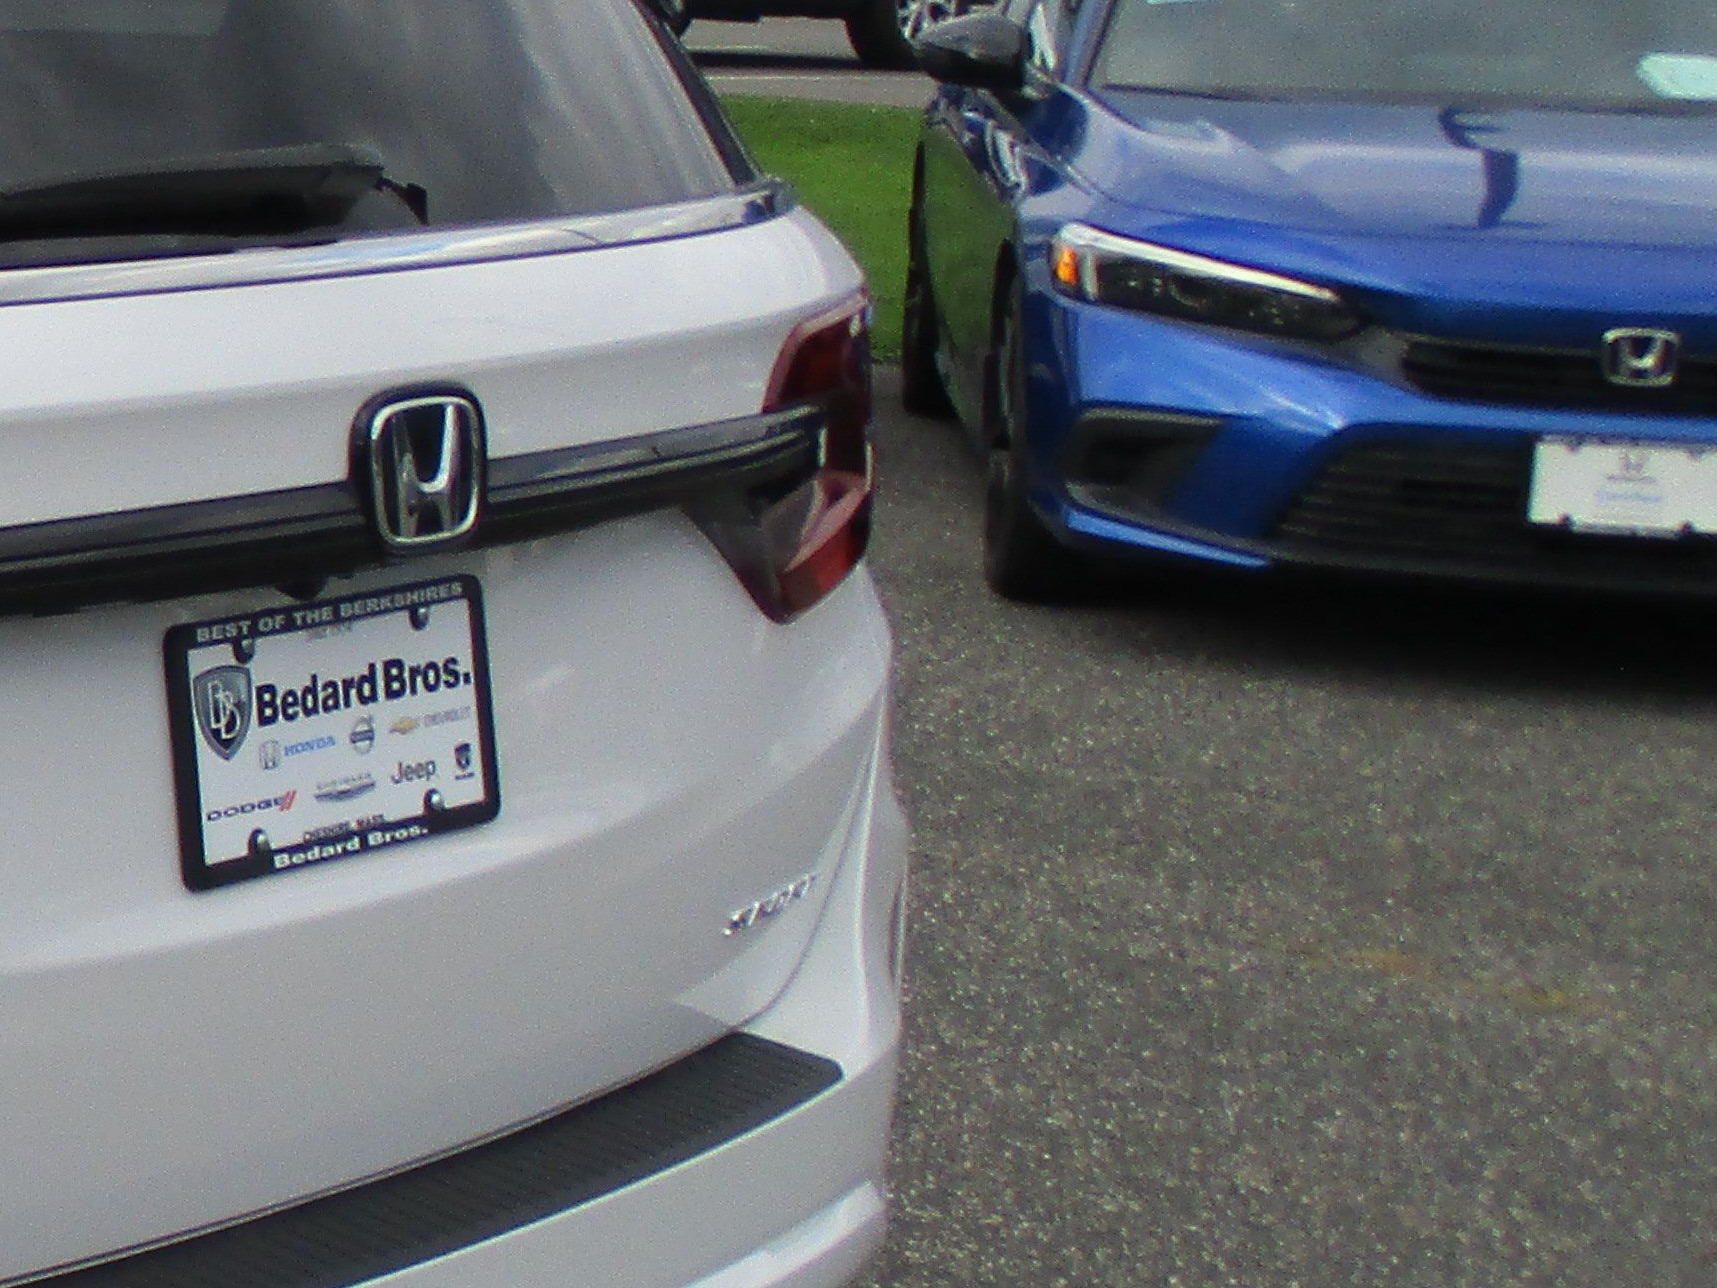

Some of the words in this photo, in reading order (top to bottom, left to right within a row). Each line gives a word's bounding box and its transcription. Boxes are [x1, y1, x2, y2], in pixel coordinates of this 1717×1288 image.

[197, 619, 252, 643] BEST
[258, 613, 287, 632] OF
[293, 606, 333, 626] THE
[340, 583, 463, 617] BERKSHIRES
[255, 662, 379, 727] Bedard
[383, 656, 472, 700] Bros.
[390, 758, 437, 785] Jeep
[273, 834, 361, 869] Bedard
[368, 825, 430, 847] Bros.
